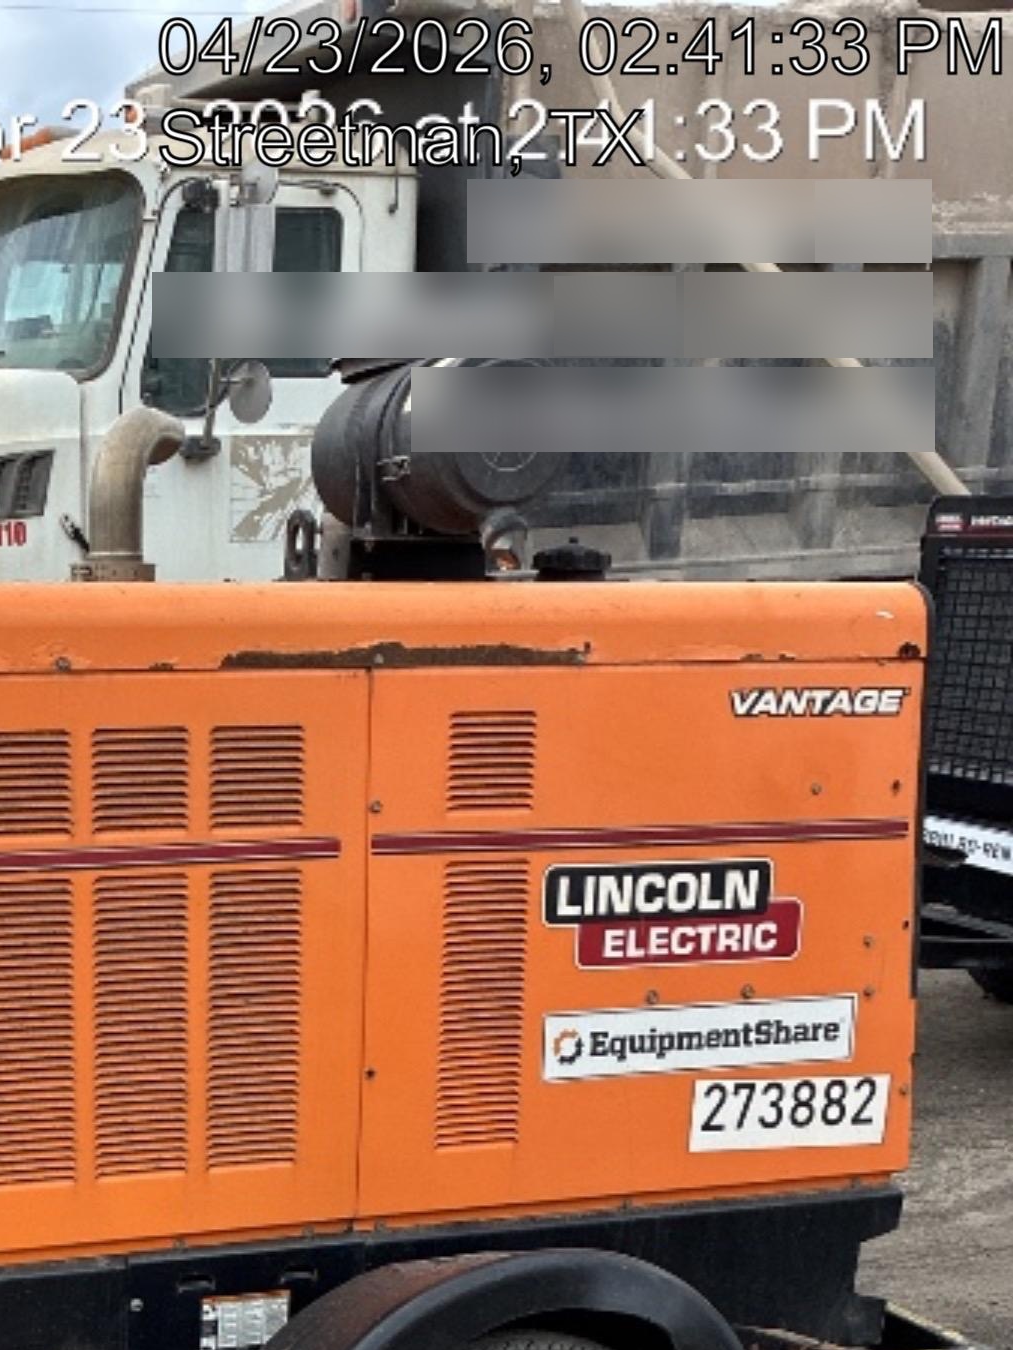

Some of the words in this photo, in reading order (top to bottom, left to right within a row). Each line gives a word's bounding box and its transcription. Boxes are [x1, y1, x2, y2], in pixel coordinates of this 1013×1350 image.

[730, 687, 906, 716] VANTAGE
[556, 869, 760, 916] LINCOLN
[602, 922, 778, 959] ELECTRIC
[589, 1018, 841, 1061] EquipmentShare
[701, 1077, 878, 1132] 273882
